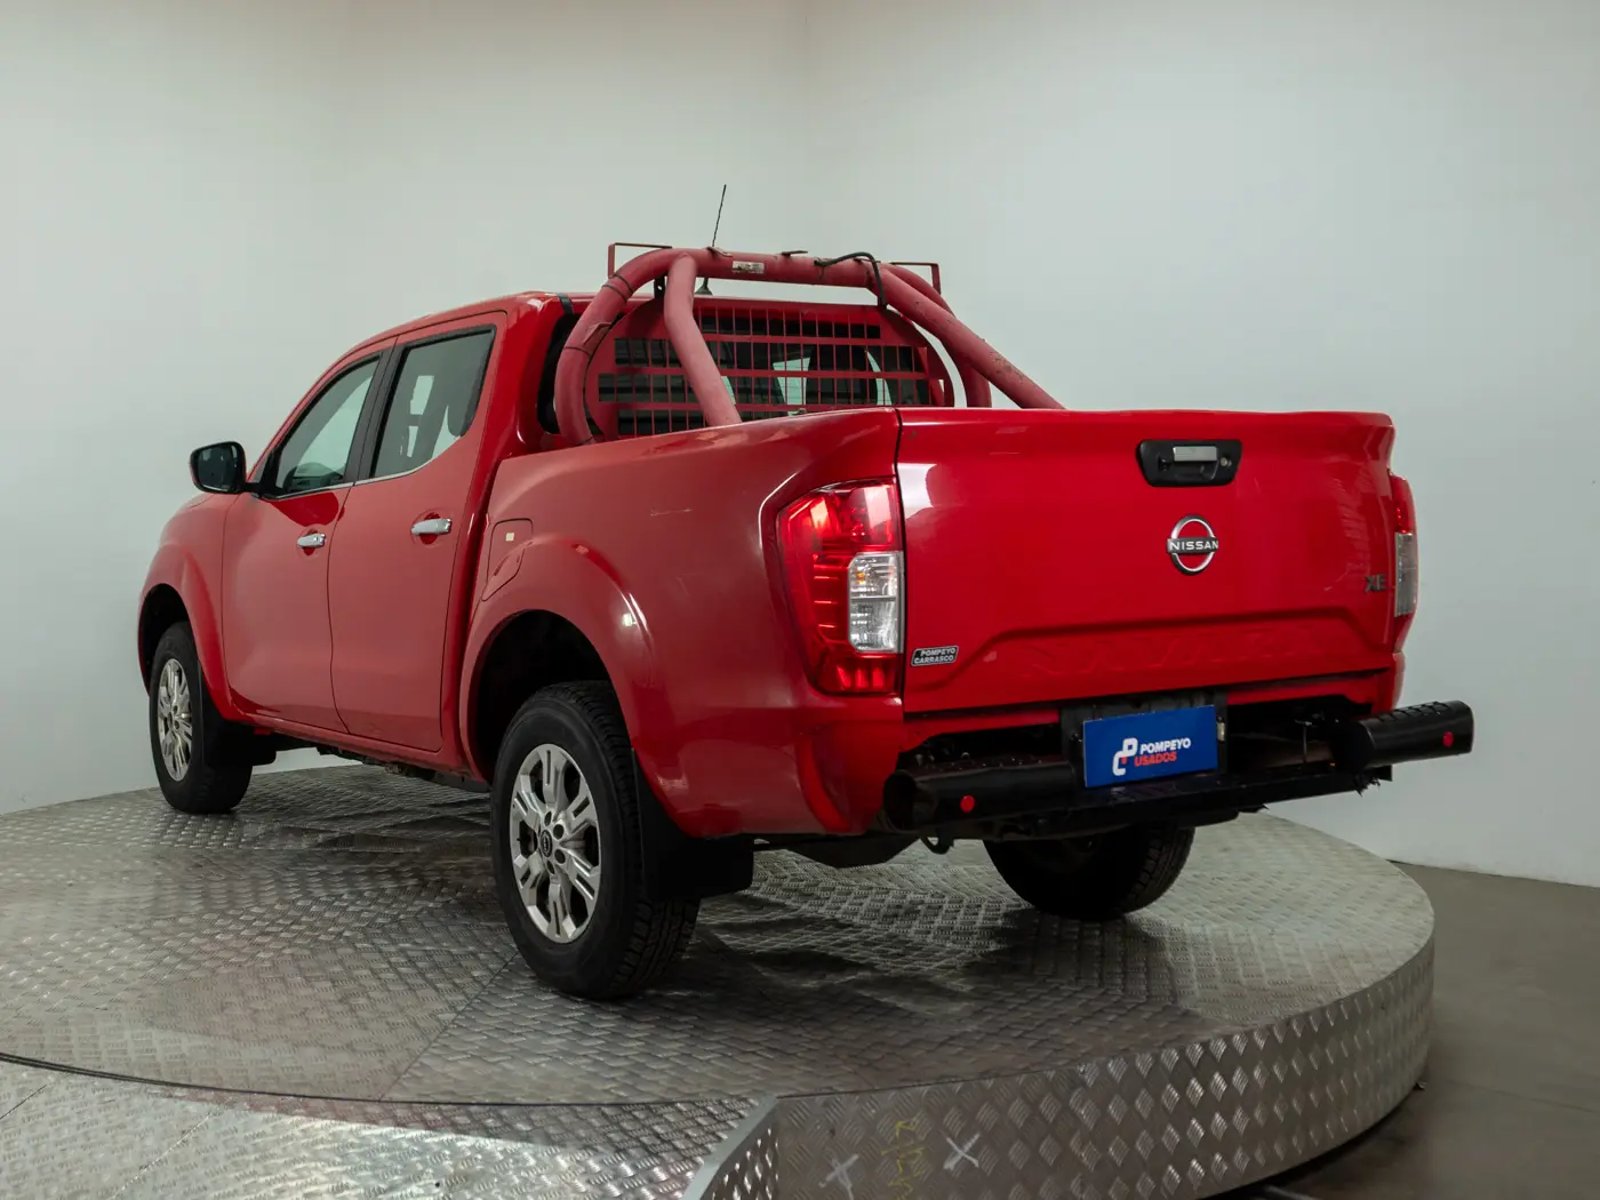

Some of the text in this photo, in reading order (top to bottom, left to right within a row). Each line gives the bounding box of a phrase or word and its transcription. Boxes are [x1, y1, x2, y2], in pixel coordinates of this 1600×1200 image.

[1169, 540, 1218, 551] NISSAN
[920, 647, 956, 657] POMPEYO
[914, 655, 954, 664] CARRASCO
[1140, 737, 1192, 755] POMPEYO
[1134, 751, 1178, 767] USADOS
